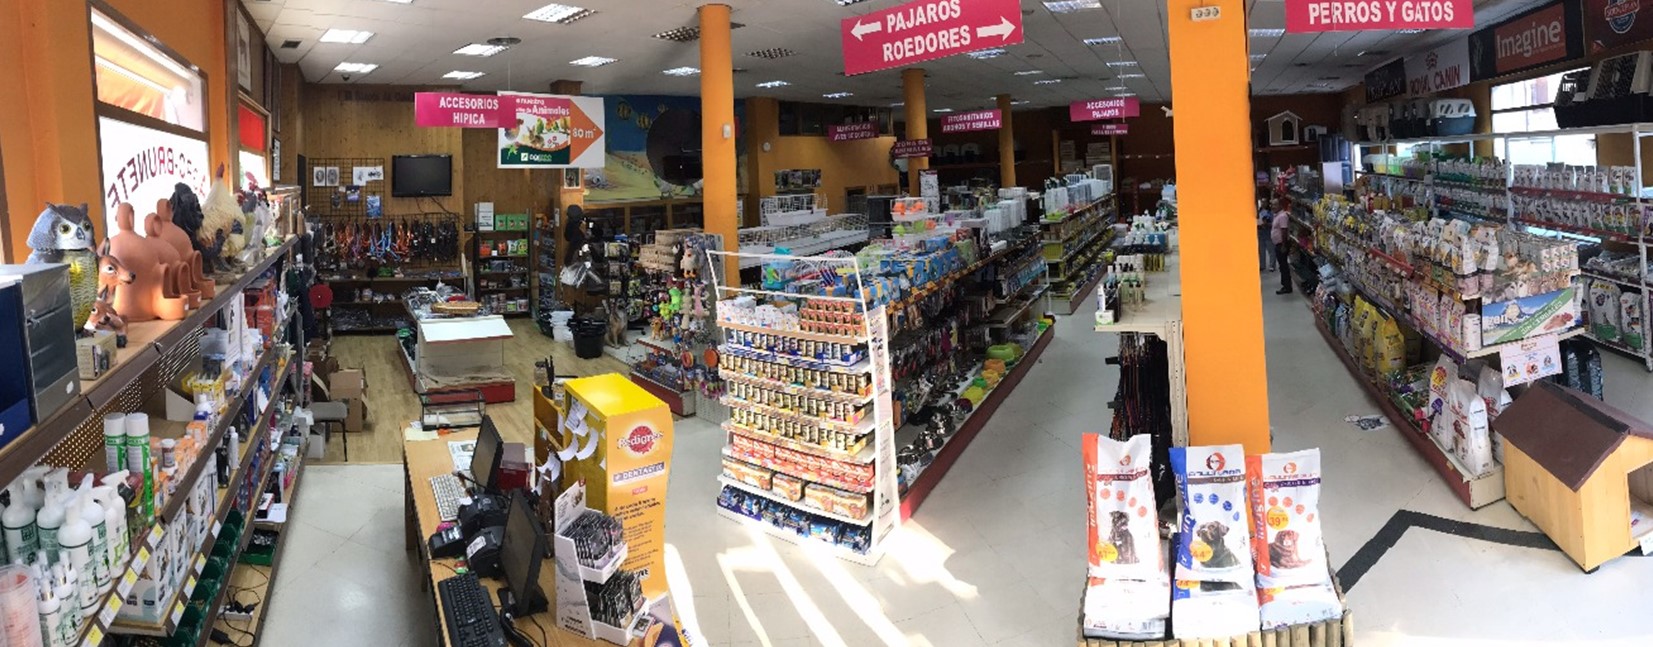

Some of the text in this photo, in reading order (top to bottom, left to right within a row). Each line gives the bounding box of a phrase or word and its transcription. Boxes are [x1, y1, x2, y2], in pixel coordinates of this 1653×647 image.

[886, 0, 961, 34] PAJAROS
[1308, 1, 1454, 25] PERROS Y GATOS
[882, 25, 971, 62] ROEDORES
[1496, 21, 1561, 59] Imagine
[1434, 64, 1460, 90] CANIN
[438, 96, 499, 110] ACCESORIOS
[1085, 99, 1124, 110] ACCESORIOS
[452, 111, 486, 125] HIPICA
